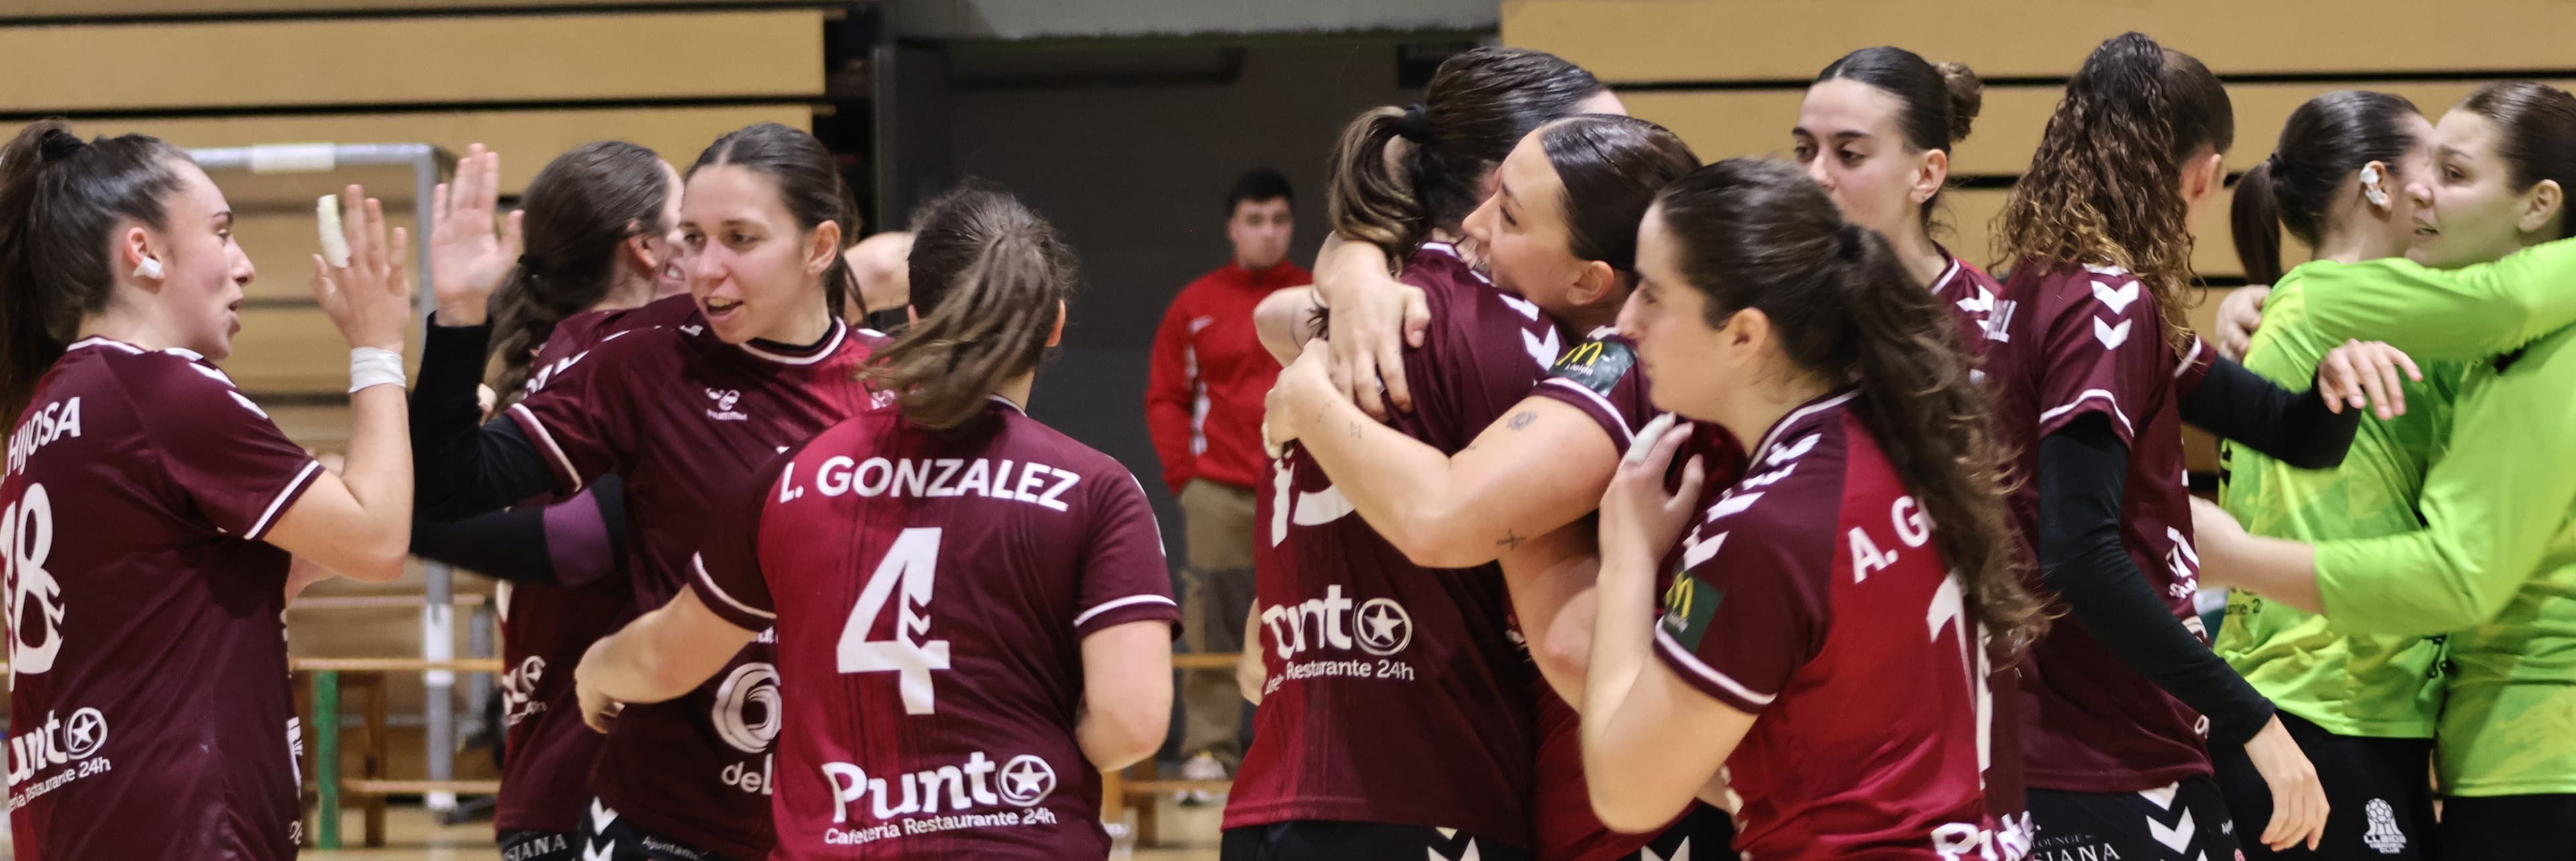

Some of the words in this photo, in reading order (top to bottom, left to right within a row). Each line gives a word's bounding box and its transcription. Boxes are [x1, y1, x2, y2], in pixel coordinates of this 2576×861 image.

[6, 396, 81, 477] HIJOSA
[780, 462, 804, 503] L.
[816, 456, 1081, 512] GONZALEZ
[1847, 525, 1898, 584] A.
[836, 526, 951, 715] 4
[1377, 658, 1415, 681] 24h
[78, 756, 112, 778] 24h
[903, 811, 1020, 837] Restaurante
[1022, 807, 1058, 825] 24h
